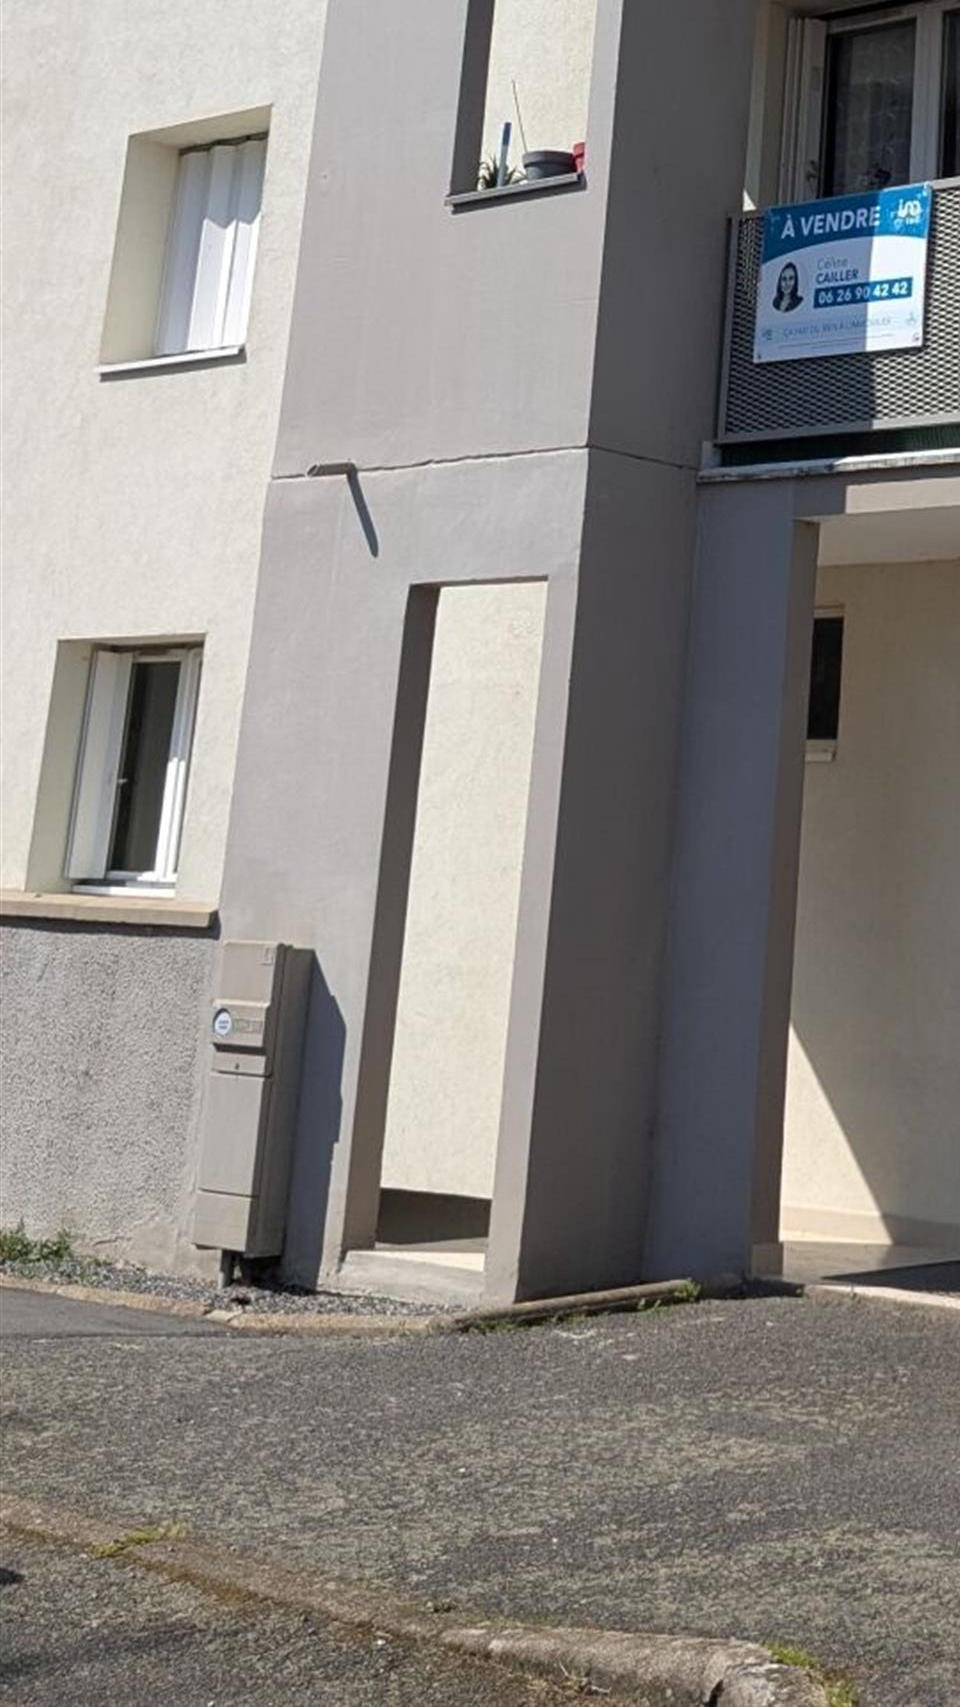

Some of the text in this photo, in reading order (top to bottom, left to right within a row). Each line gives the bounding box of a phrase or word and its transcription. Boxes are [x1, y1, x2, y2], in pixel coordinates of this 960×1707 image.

[781, 205, 881, 239] À VENDRE
[816, 268, 860, 285] CAILLER
[818, 281, 908, 304] 06 26 90 42 42
